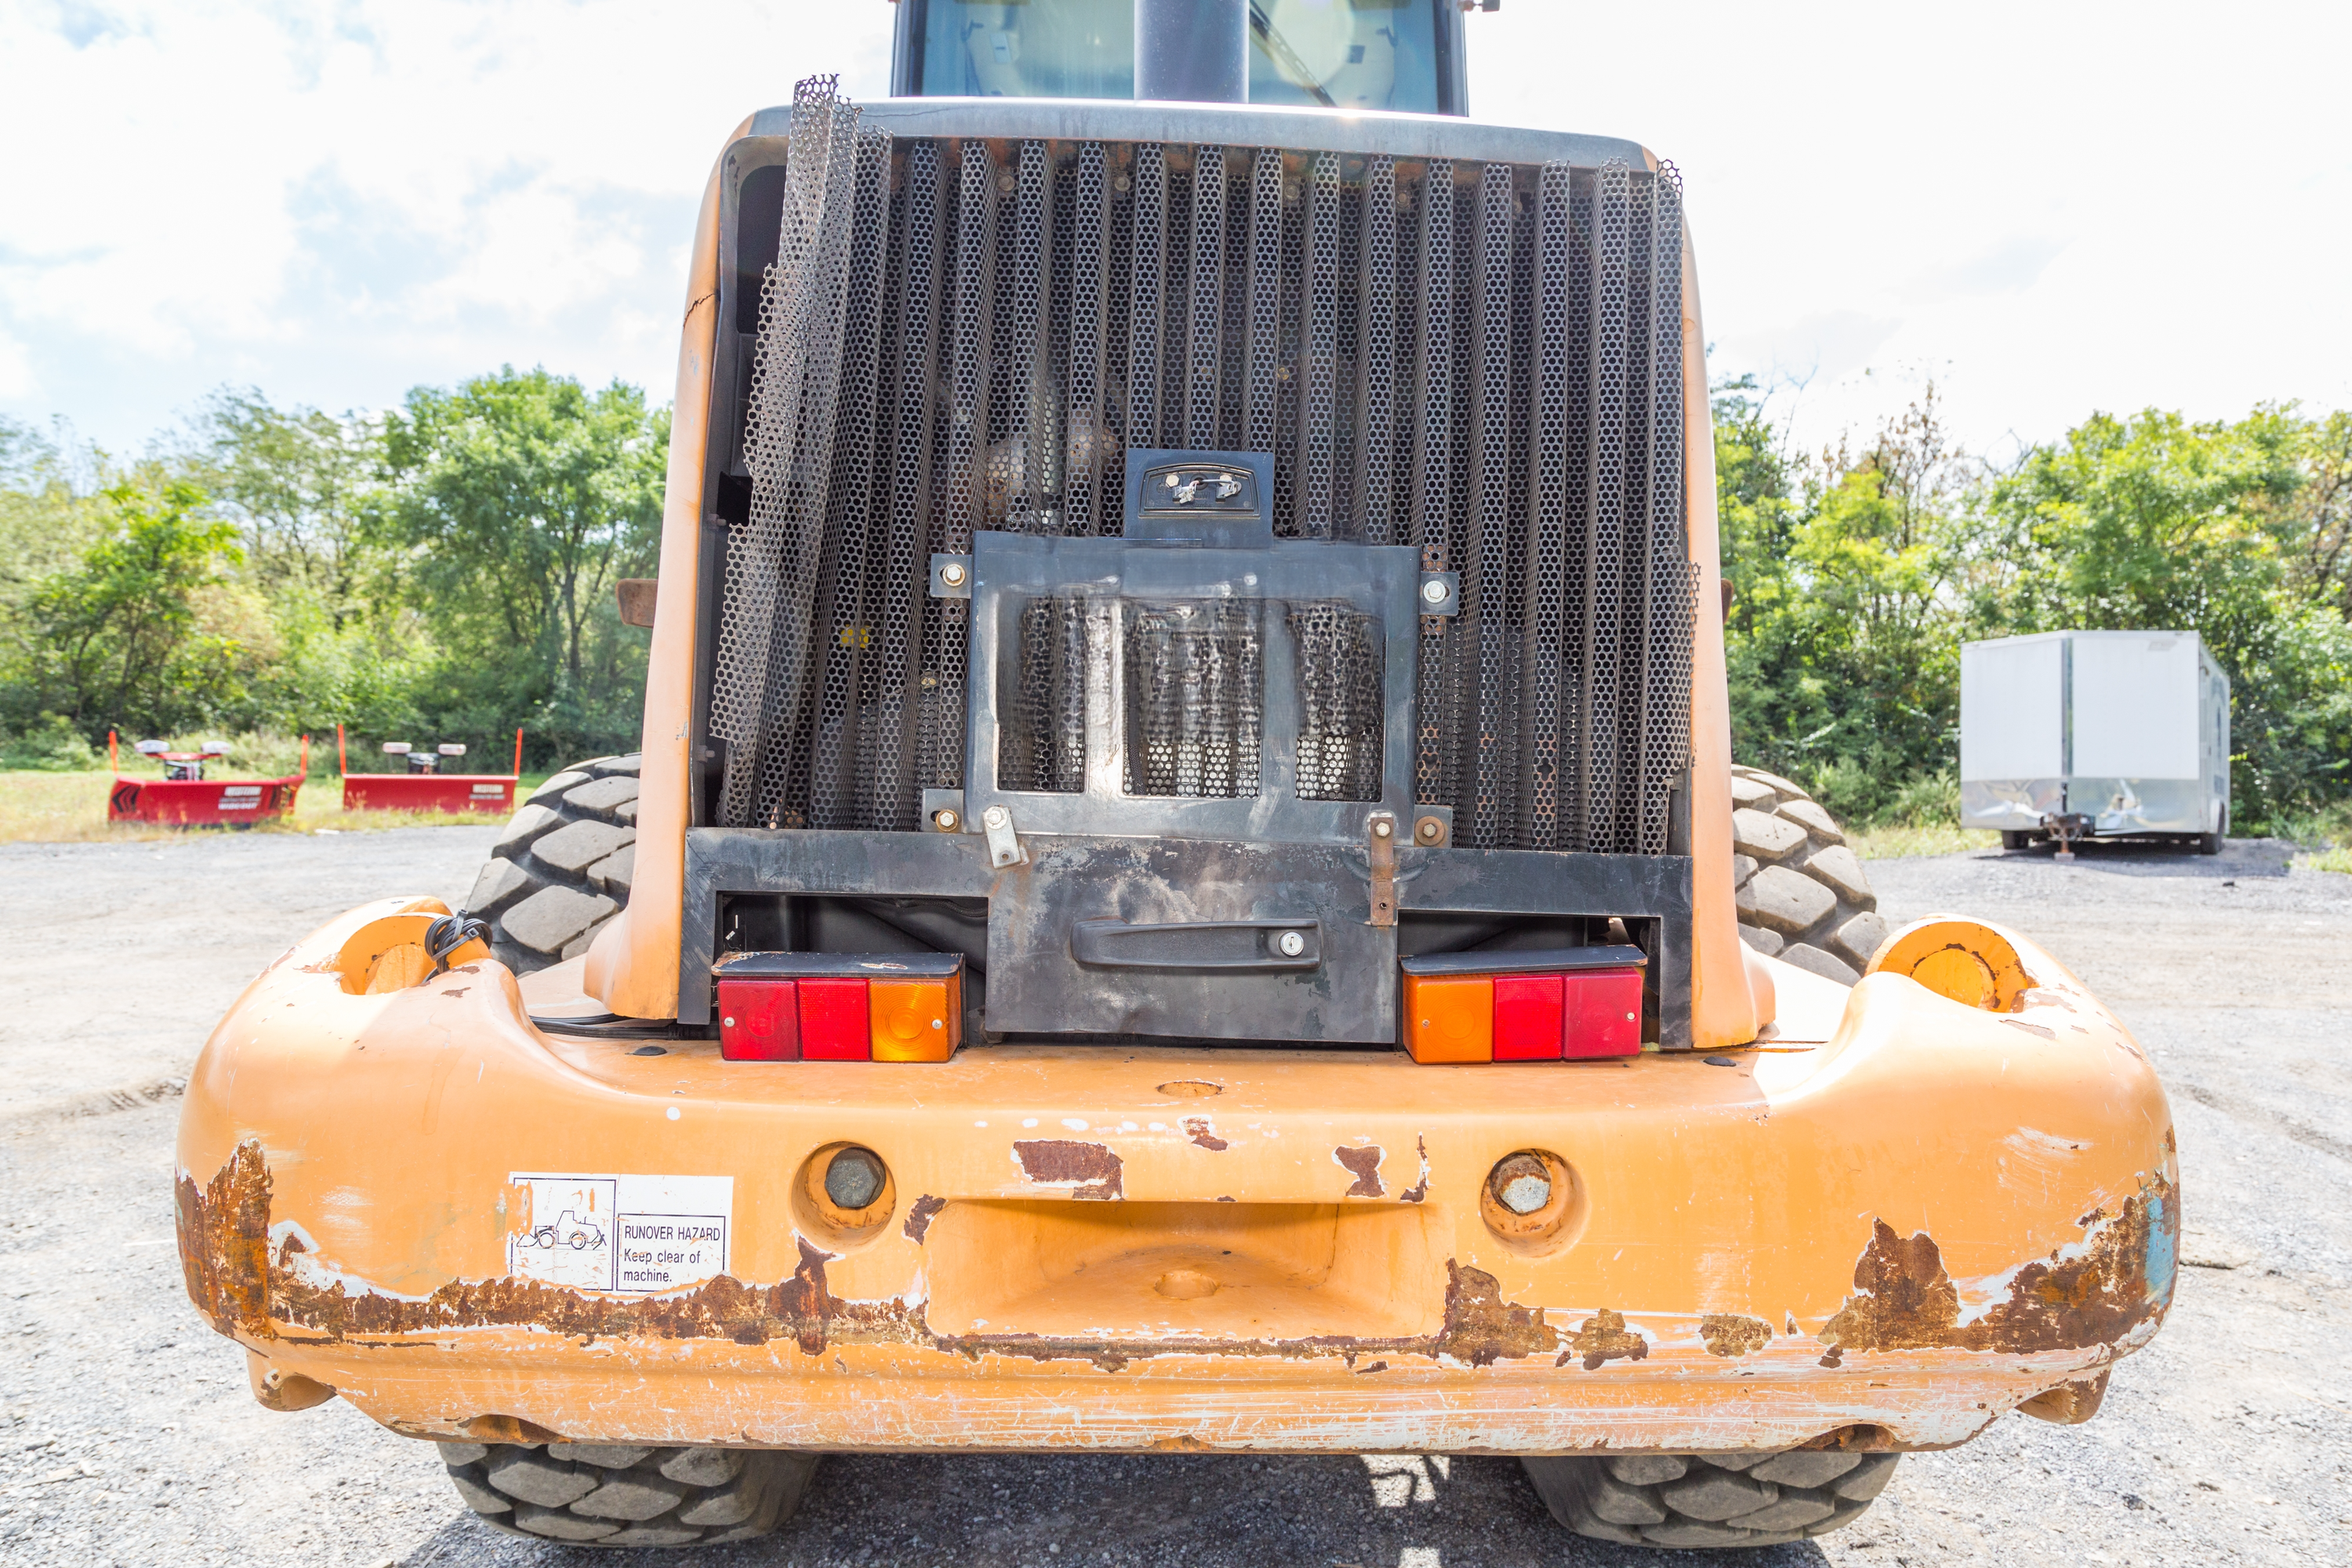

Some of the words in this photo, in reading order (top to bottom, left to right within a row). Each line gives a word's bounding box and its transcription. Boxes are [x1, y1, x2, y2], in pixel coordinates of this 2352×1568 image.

[624, 1225, 673, 1240] RUNOVER
[677, 1226, 720, 1241] HAZARD
[624, 1248, 652, 1265] Keep
[657, 1249, 684, 1263] clear
[689, 1250, 701, 1264] of
[623, 1269, 673, 1283] machine.
